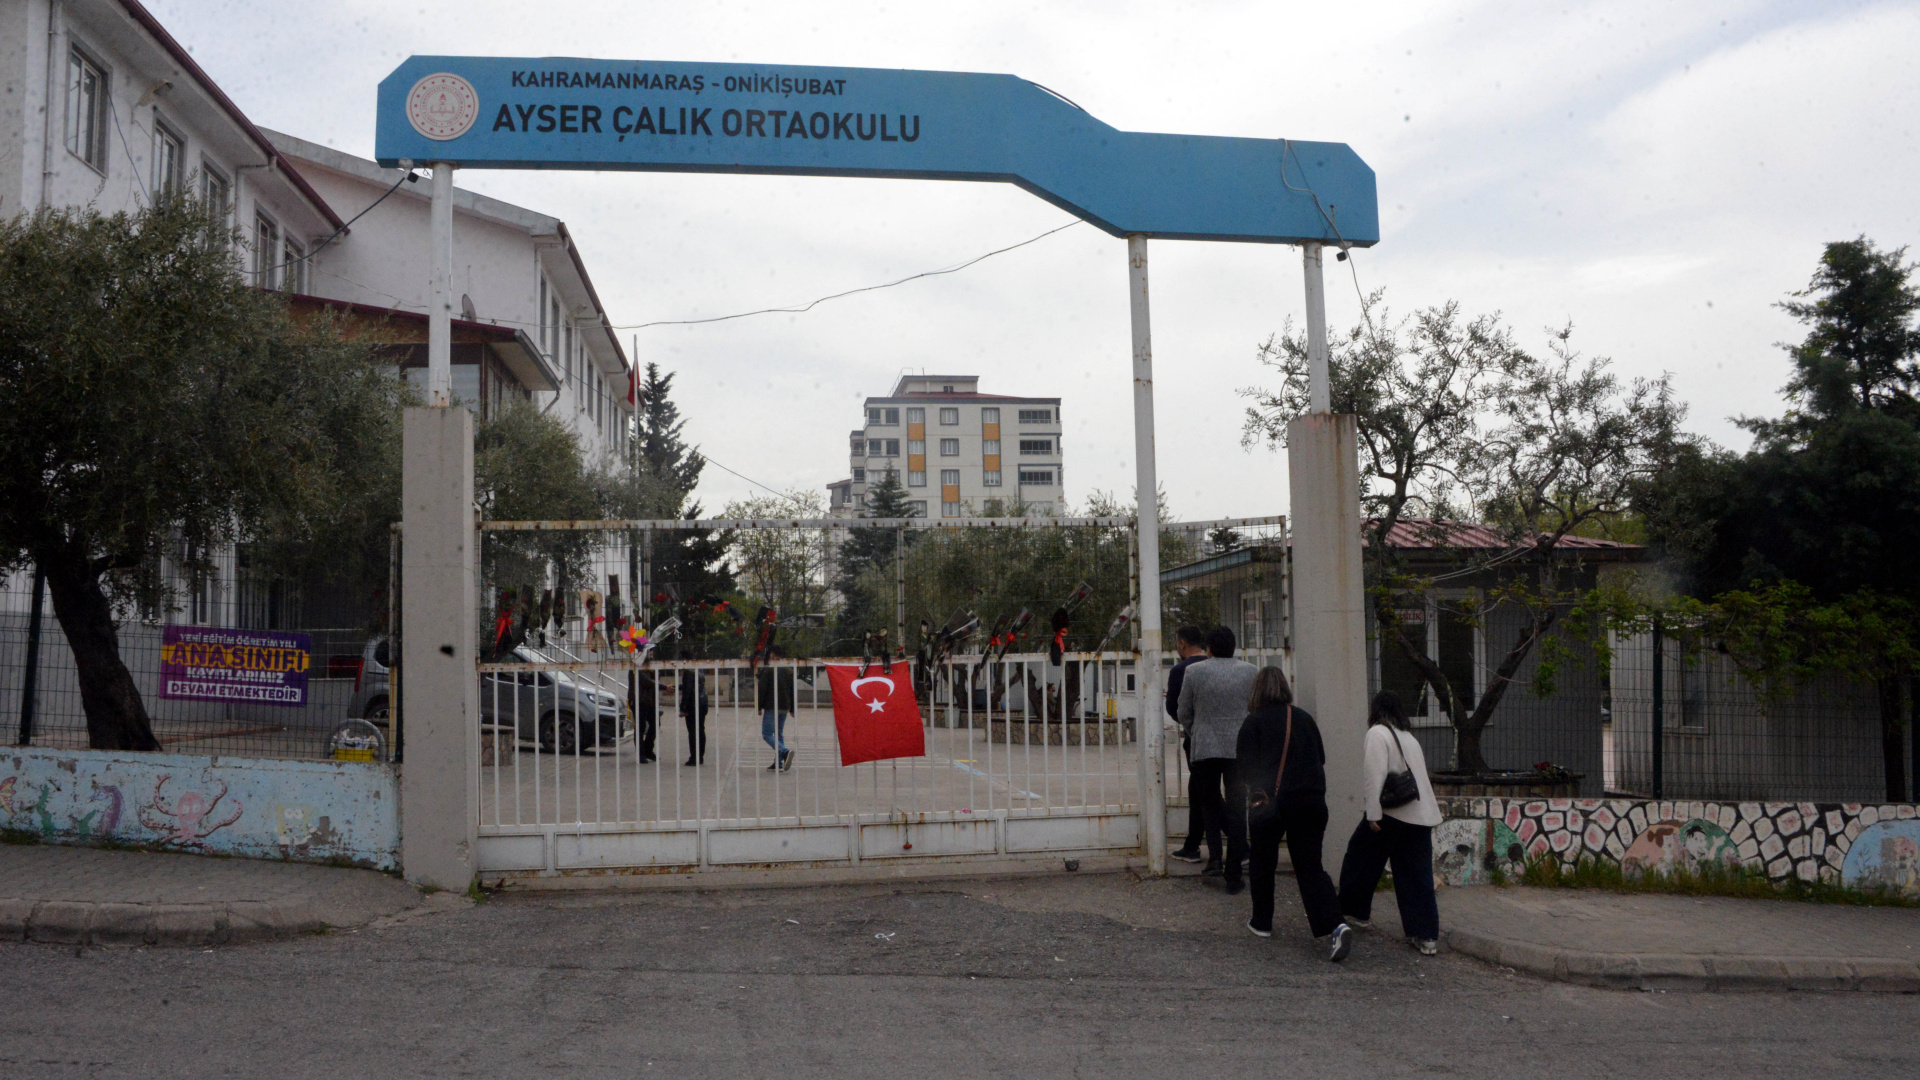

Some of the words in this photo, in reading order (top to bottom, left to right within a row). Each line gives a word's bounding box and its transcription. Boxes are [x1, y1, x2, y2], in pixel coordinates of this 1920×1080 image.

[512, 71, 705, 95] KAHRAMANMARAŞ
[724, 73, 846, 98] ONİKİŞUBAT
[492, 103, 602, 134] AYSER
[613, 105, 713, 142] ÇALIK
[722, 108, 920, 142] ORTAOKULU
[180, 632, 202, 643] YENİ
[203, 633, 235, 645] EĞİTİM
[236, 635, 278, 646] ÖĞRETİM
[279, 639, 297, 649] YILI
[169, 642, 227, 668] ANA
[231, 645, 305, 673] SINIFI
[186, 667, 285, 683] KAYITLARIMIZ
[171, 682, 216, 696] DEVAM
[219, 684, 297, 701] ETMEKTEDİR
